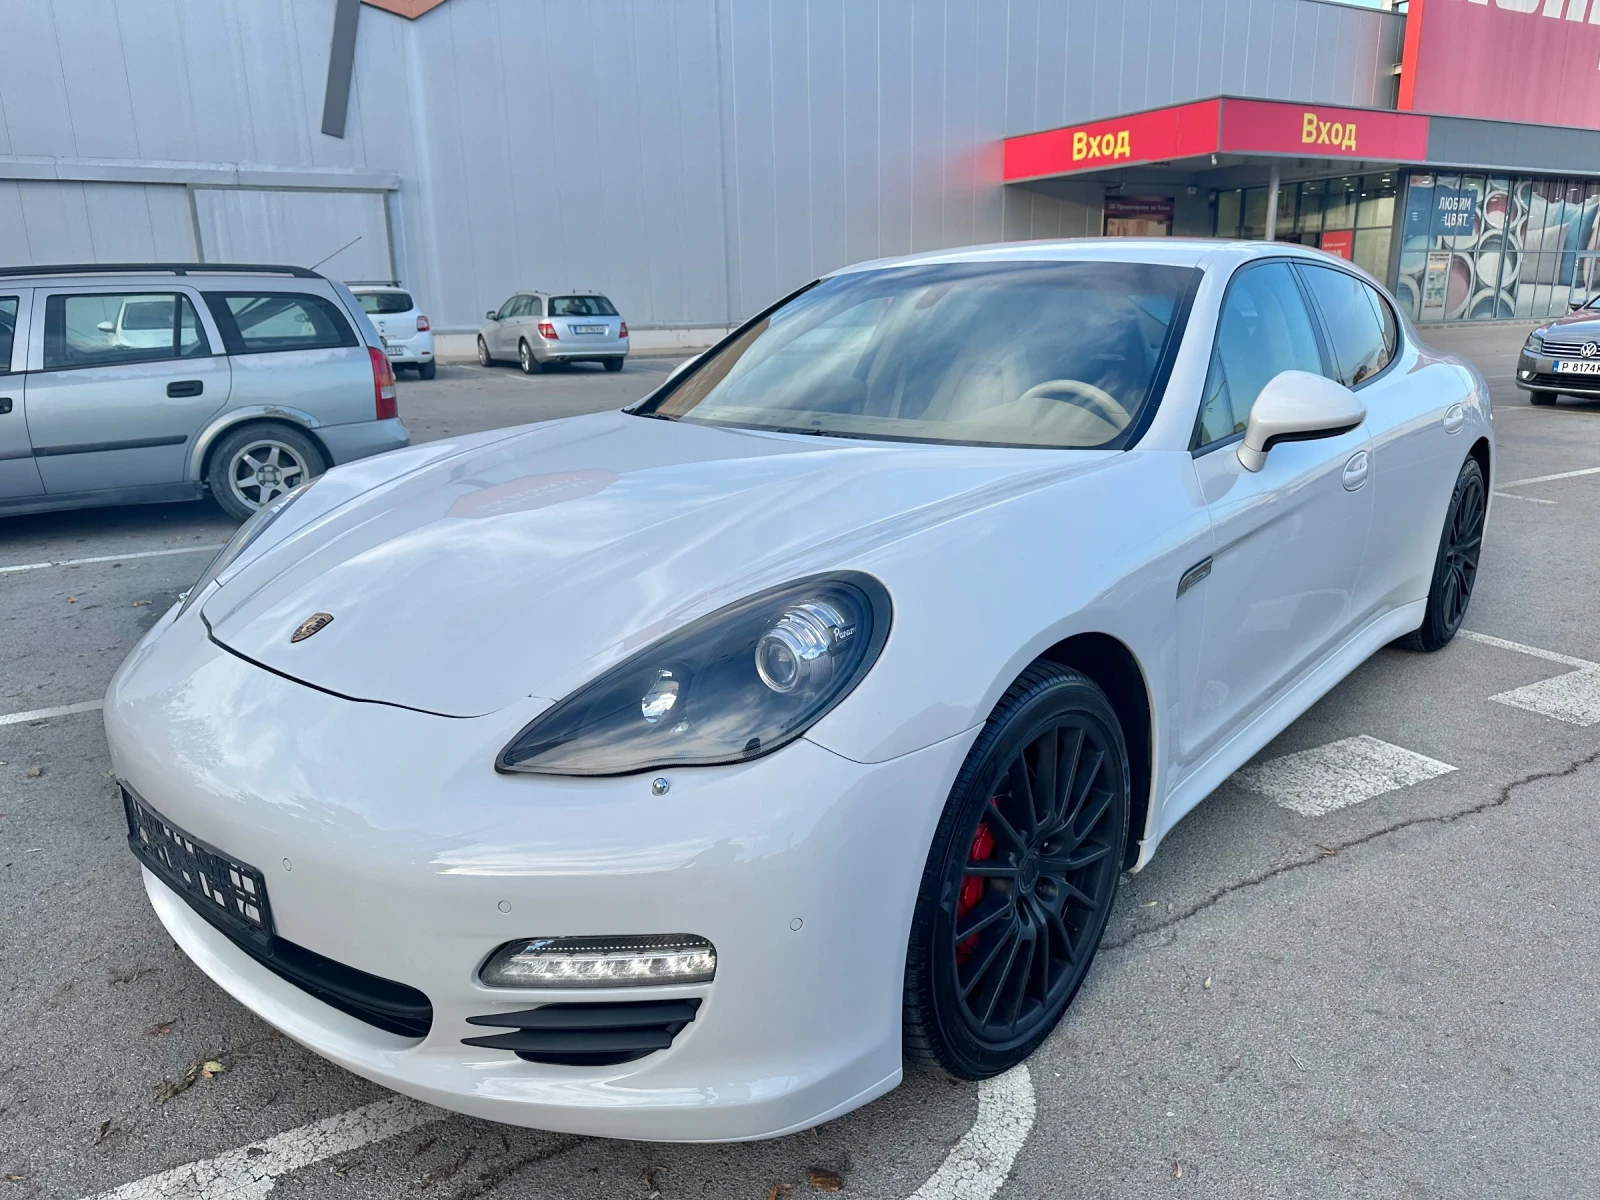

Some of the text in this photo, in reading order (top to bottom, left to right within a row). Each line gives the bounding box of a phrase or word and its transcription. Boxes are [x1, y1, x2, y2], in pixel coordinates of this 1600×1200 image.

[1302, 112, 1357, 151] Вход
[1072, 130, 1131, 161] Вход
[1438, 196, 1472, 211] ЛЮБИМ
[1444, 213, 1469, 228] ЦВЯТ
[1562, 362, 1568, 371] P
